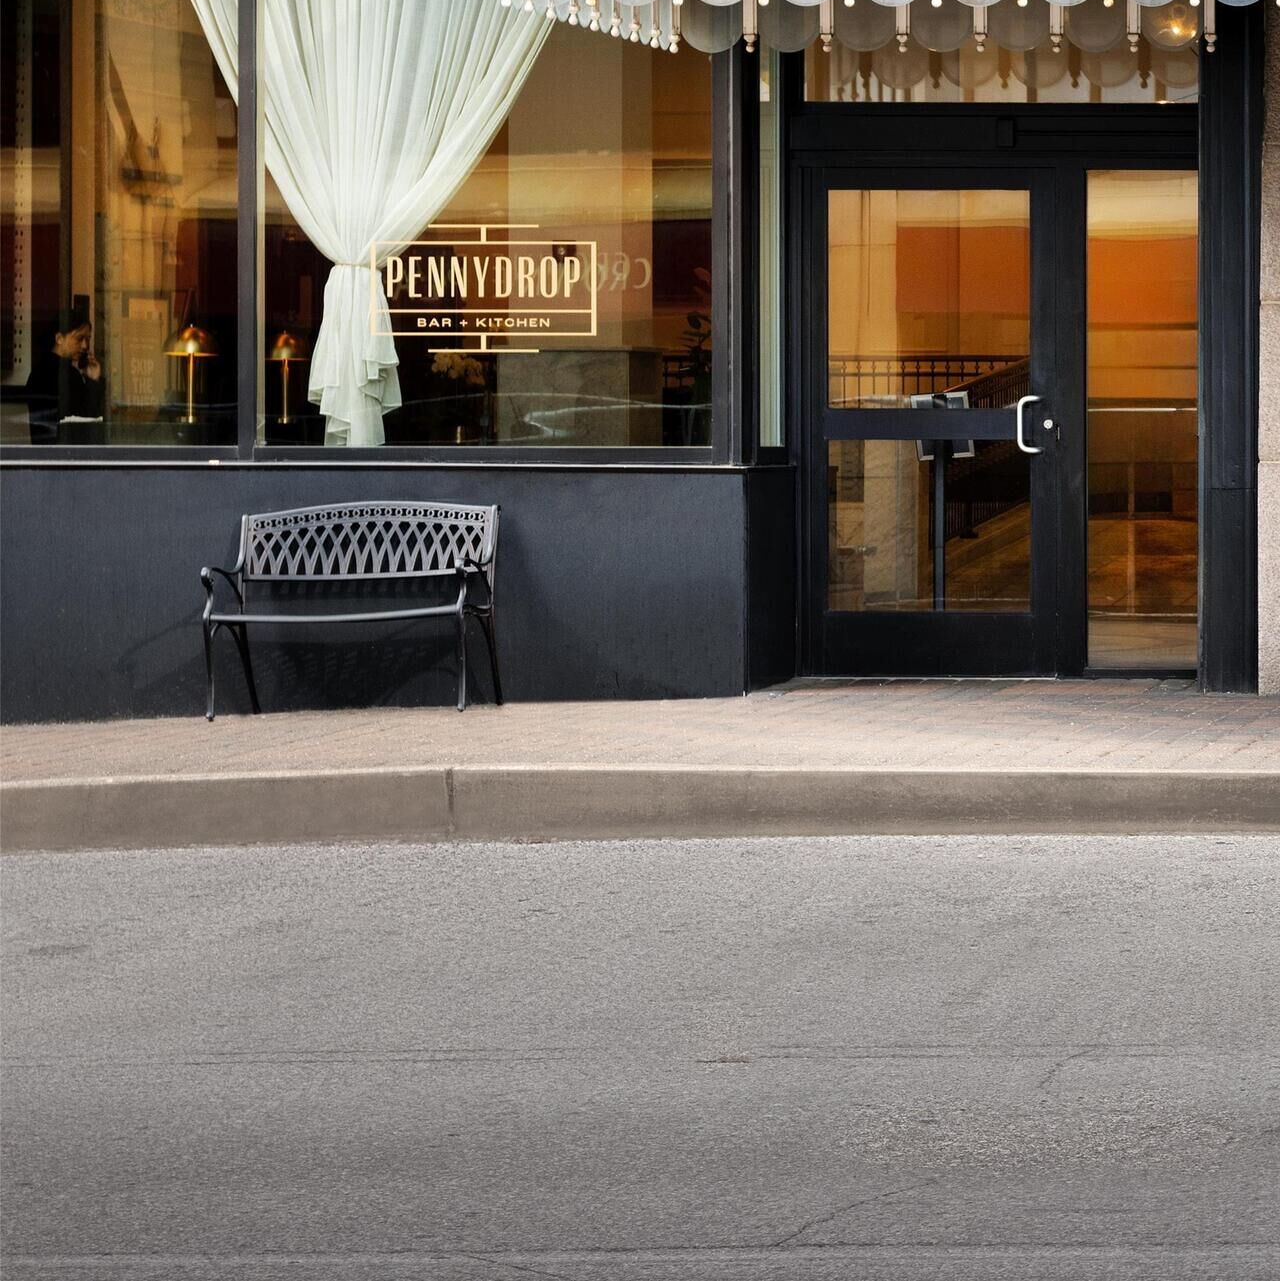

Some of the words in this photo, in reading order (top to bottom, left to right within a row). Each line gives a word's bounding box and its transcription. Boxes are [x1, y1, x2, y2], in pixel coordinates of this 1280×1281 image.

[385, 255, 581, 298] PENNYDROP
[416, 317, 452, 328] BAR
[475, 317, 551, 328] KITCHEN
